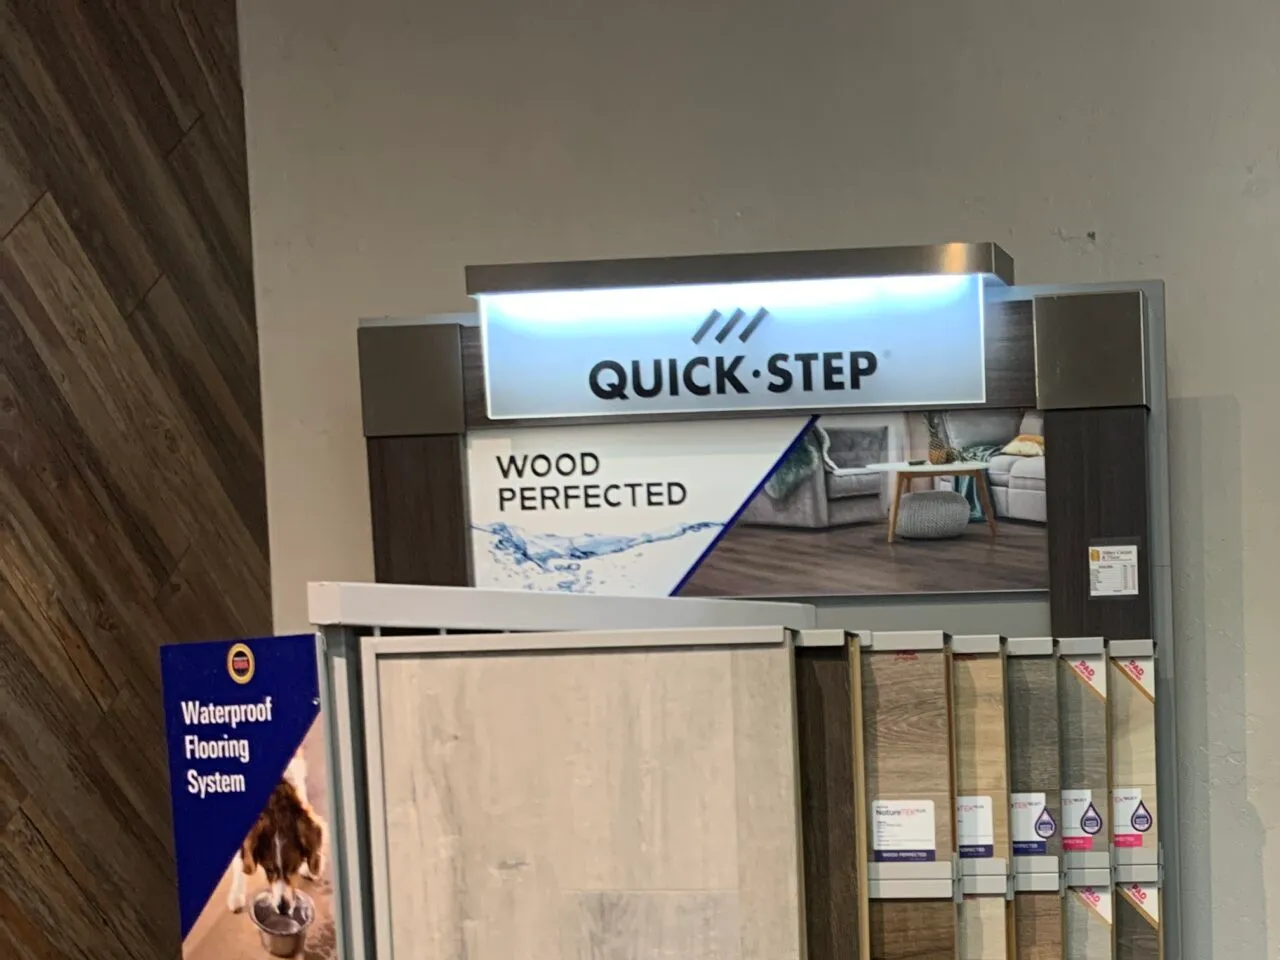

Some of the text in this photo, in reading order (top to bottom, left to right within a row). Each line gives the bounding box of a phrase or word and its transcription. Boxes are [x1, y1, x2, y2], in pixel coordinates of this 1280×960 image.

[496, 452, 600, 479] WOOD
[498, 481, 687, 512] PERFECTED
[181, 697, 273, 728] Waterproof
[185, 734, 250, 763] Flooring
[187, 769, 246, 799] System
